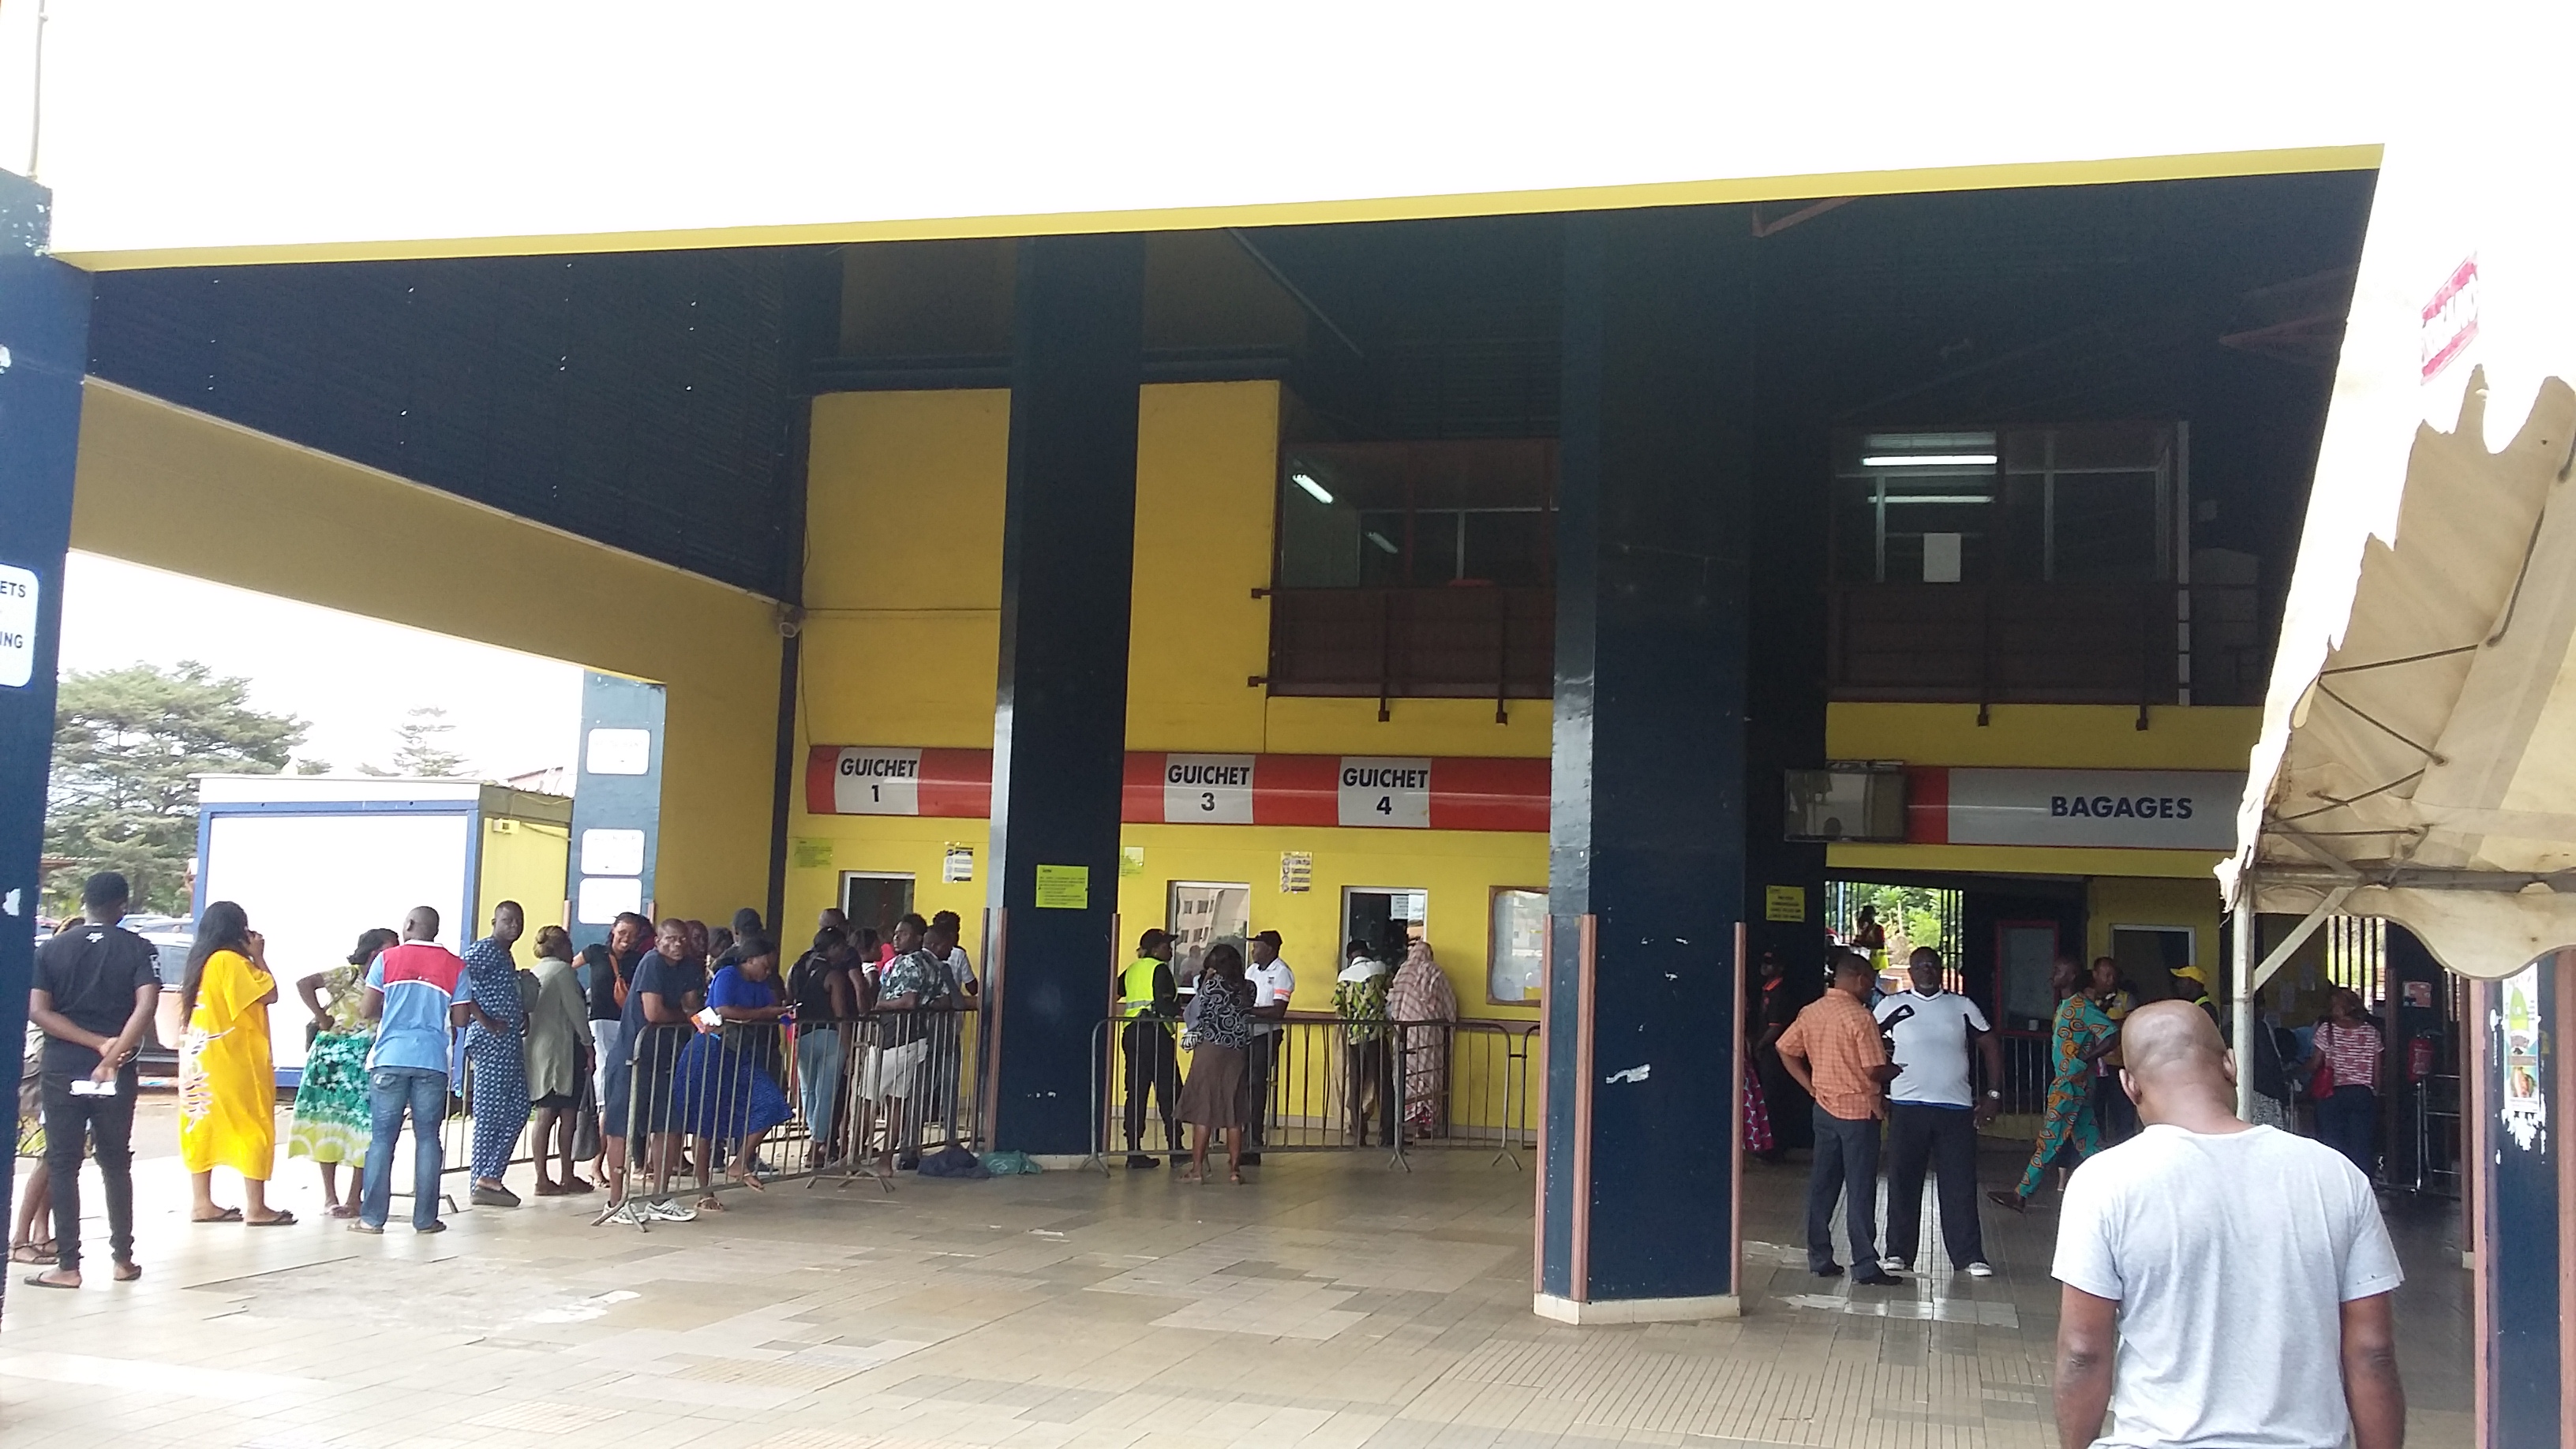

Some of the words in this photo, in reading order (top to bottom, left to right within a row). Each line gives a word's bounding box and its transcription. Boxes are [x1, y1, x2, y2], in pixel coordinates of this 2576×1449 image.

[841, 758, 918, 777] GUICHET
[1168, 764, 1250, 785] GUICHET
[1343, 768, 1428, 788] GUICHET
[871, 784, 879, 803] 1
[1200, 792, 1215, 811] 3
[1376, 796, 1392, 815] 4
[2051, 796, 2193, 819] BAGAGES
